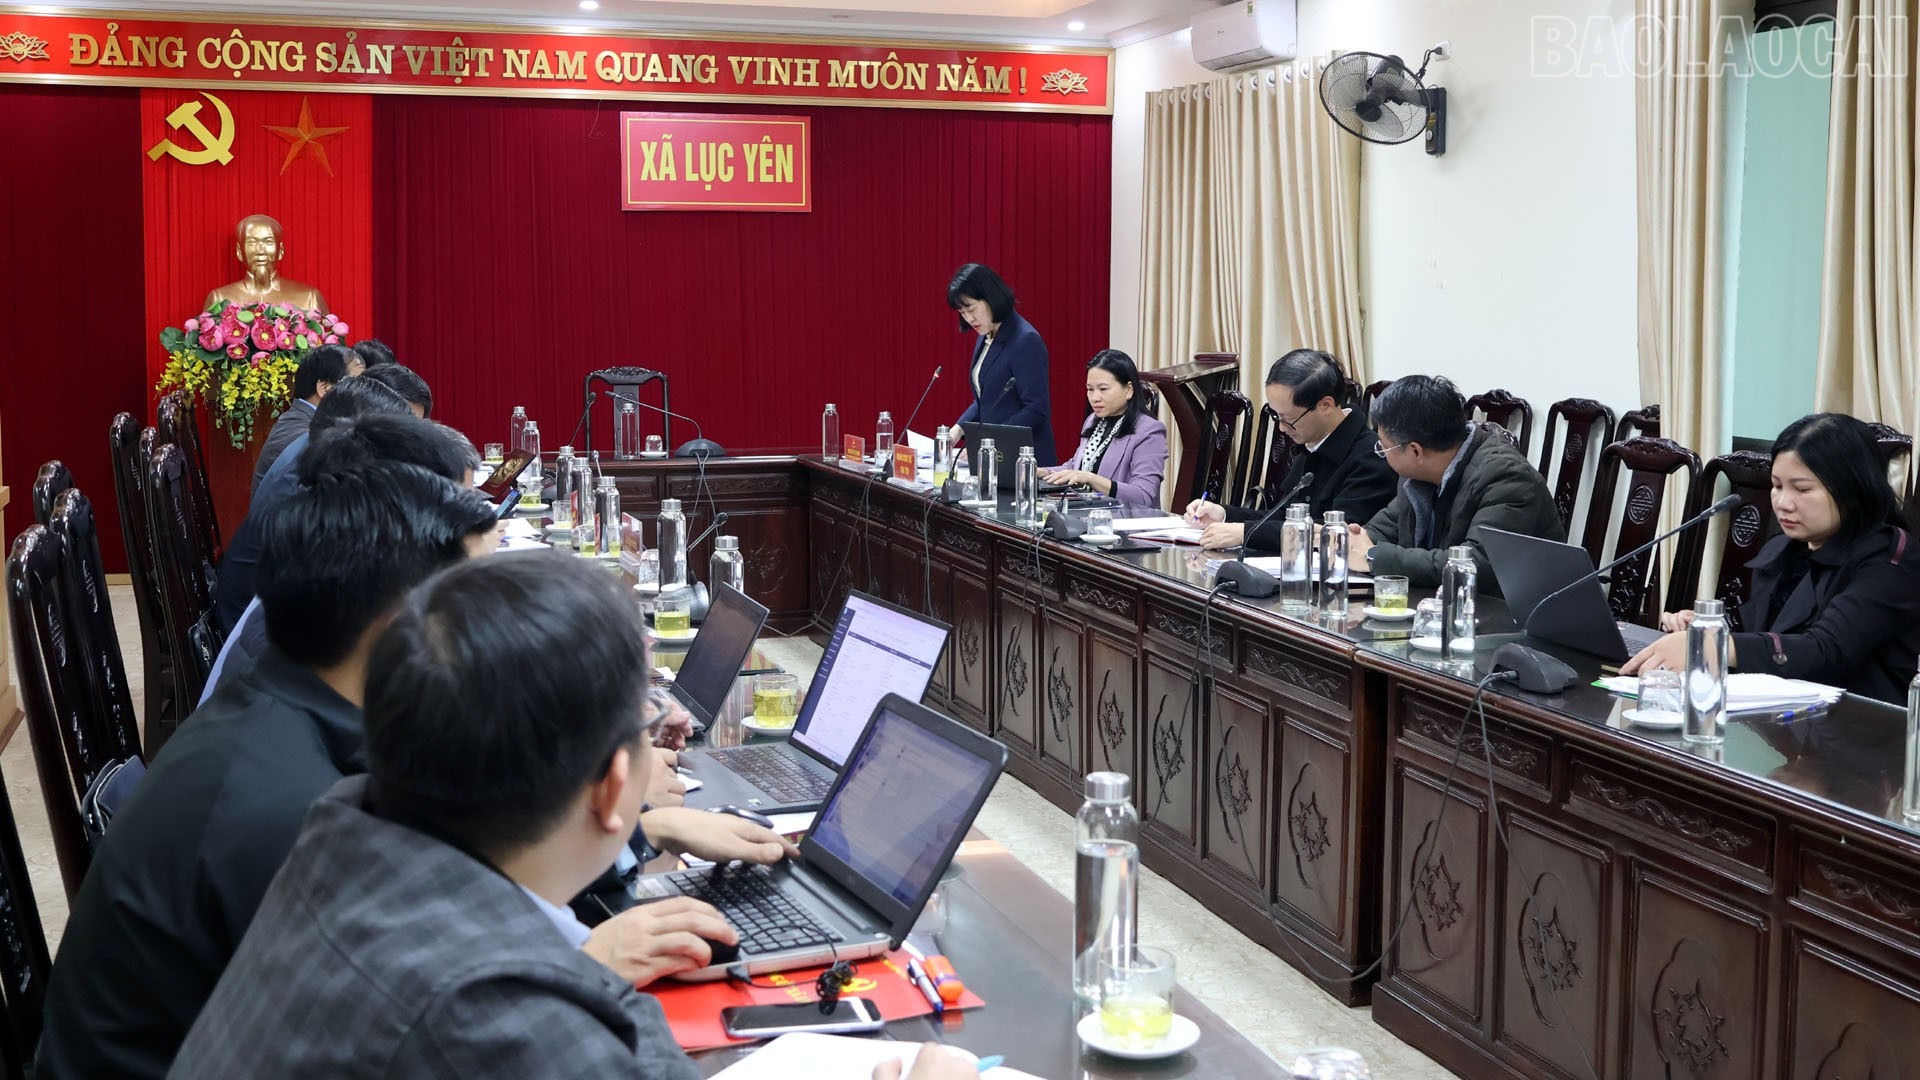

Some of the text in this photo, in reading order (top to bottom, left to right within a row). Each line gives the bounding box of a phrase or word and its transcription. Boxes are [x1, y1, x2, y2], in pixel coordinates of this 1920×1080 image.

[68, 22, 188, 68] ĐẢNG
[196, 28, 308, 78] CỘNG
[315, 30, 394, 75] SẢN
[402, 37, 494, 84] VIỆT
[502, 48, 588, 80] NAM
[594, 50, 718, 84] QUANG
[727, 55, 820, 88] VINH
[827, 52, 930, 91] MUÔN
[936, 57, 1012, 94] NĂM
[640, 132, 794, 192] XÃ LỤC YÊN
